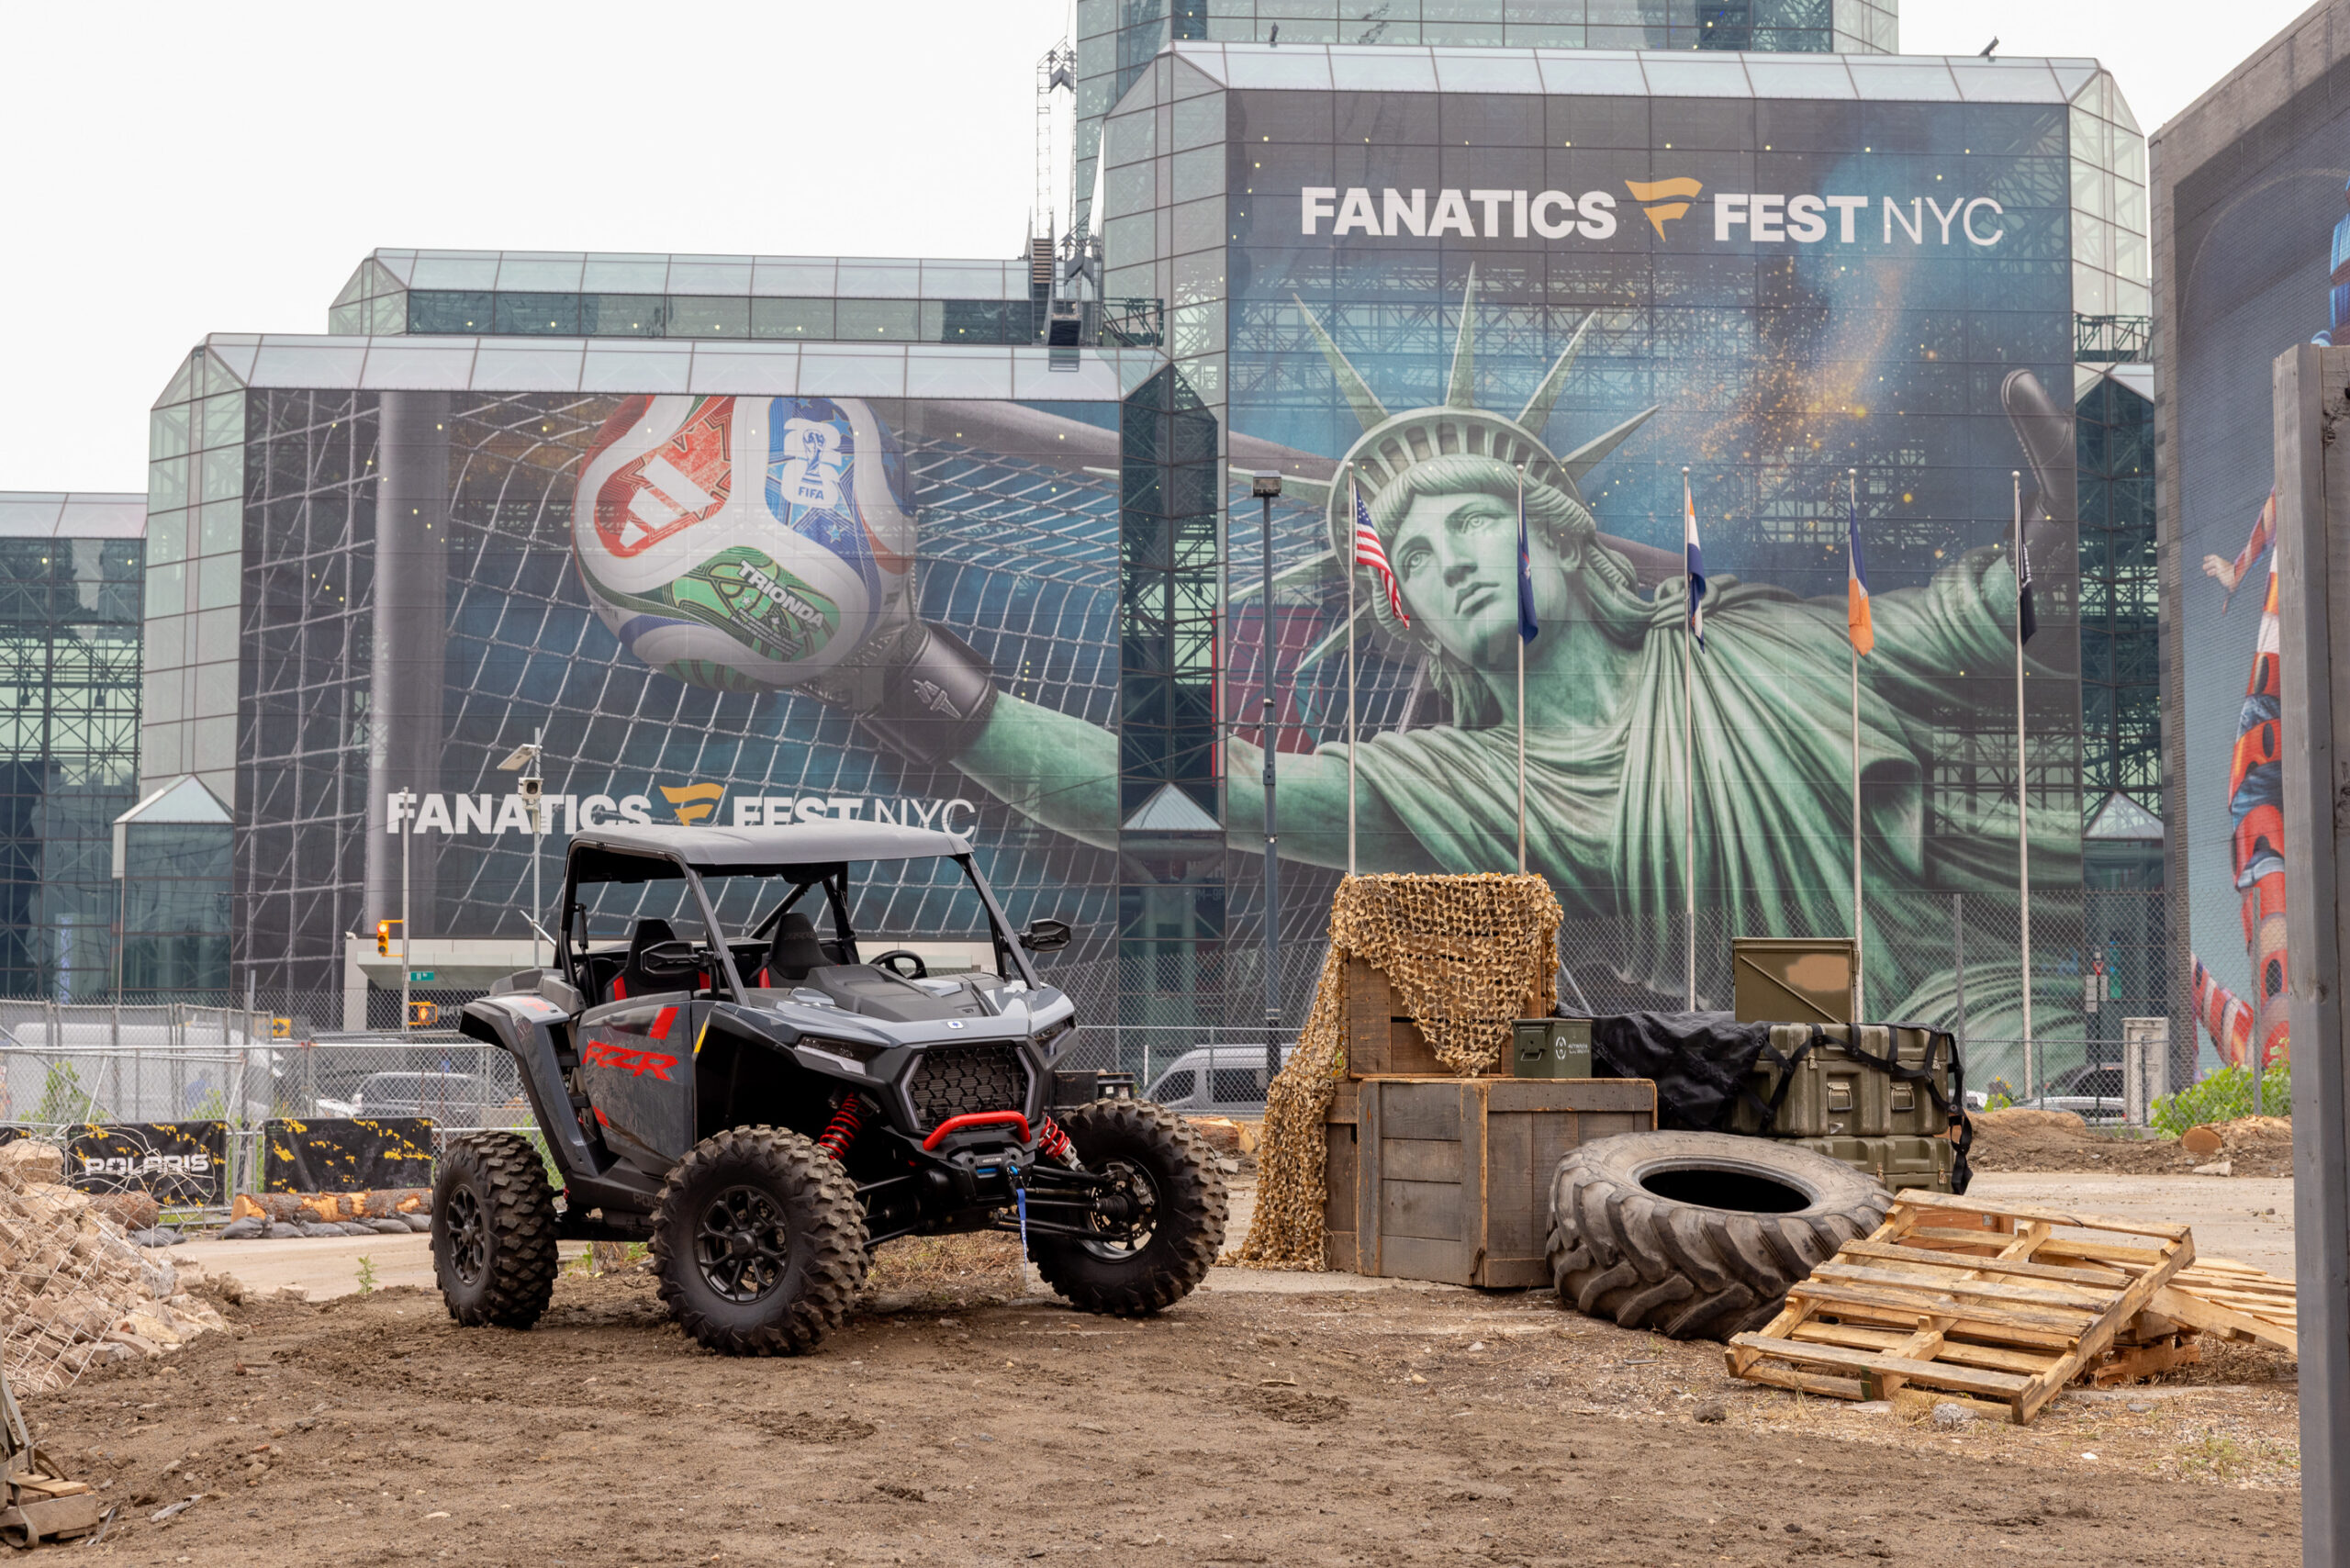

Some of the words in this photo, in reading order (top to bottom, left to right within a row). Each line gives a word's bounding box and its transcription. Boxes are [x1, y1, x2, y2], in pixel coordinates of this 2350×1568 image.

[1301, 186, 1617, 240] FANATICS
[1714, 194, 1868, 242] FEST
[1884, 196, 2004, 246] NYC
[798, 486, 824, 500] FIFA
[738, 559, 824, 628] TRIONDA
[386, 793, 652, 834] FANATICS
[733, 797, 864, 826] FEST
[874, 799, 976, 838] NYC
[581, 1039, 678, 1081] RZR
[85, 1153, 209, 1176] POLARIS
